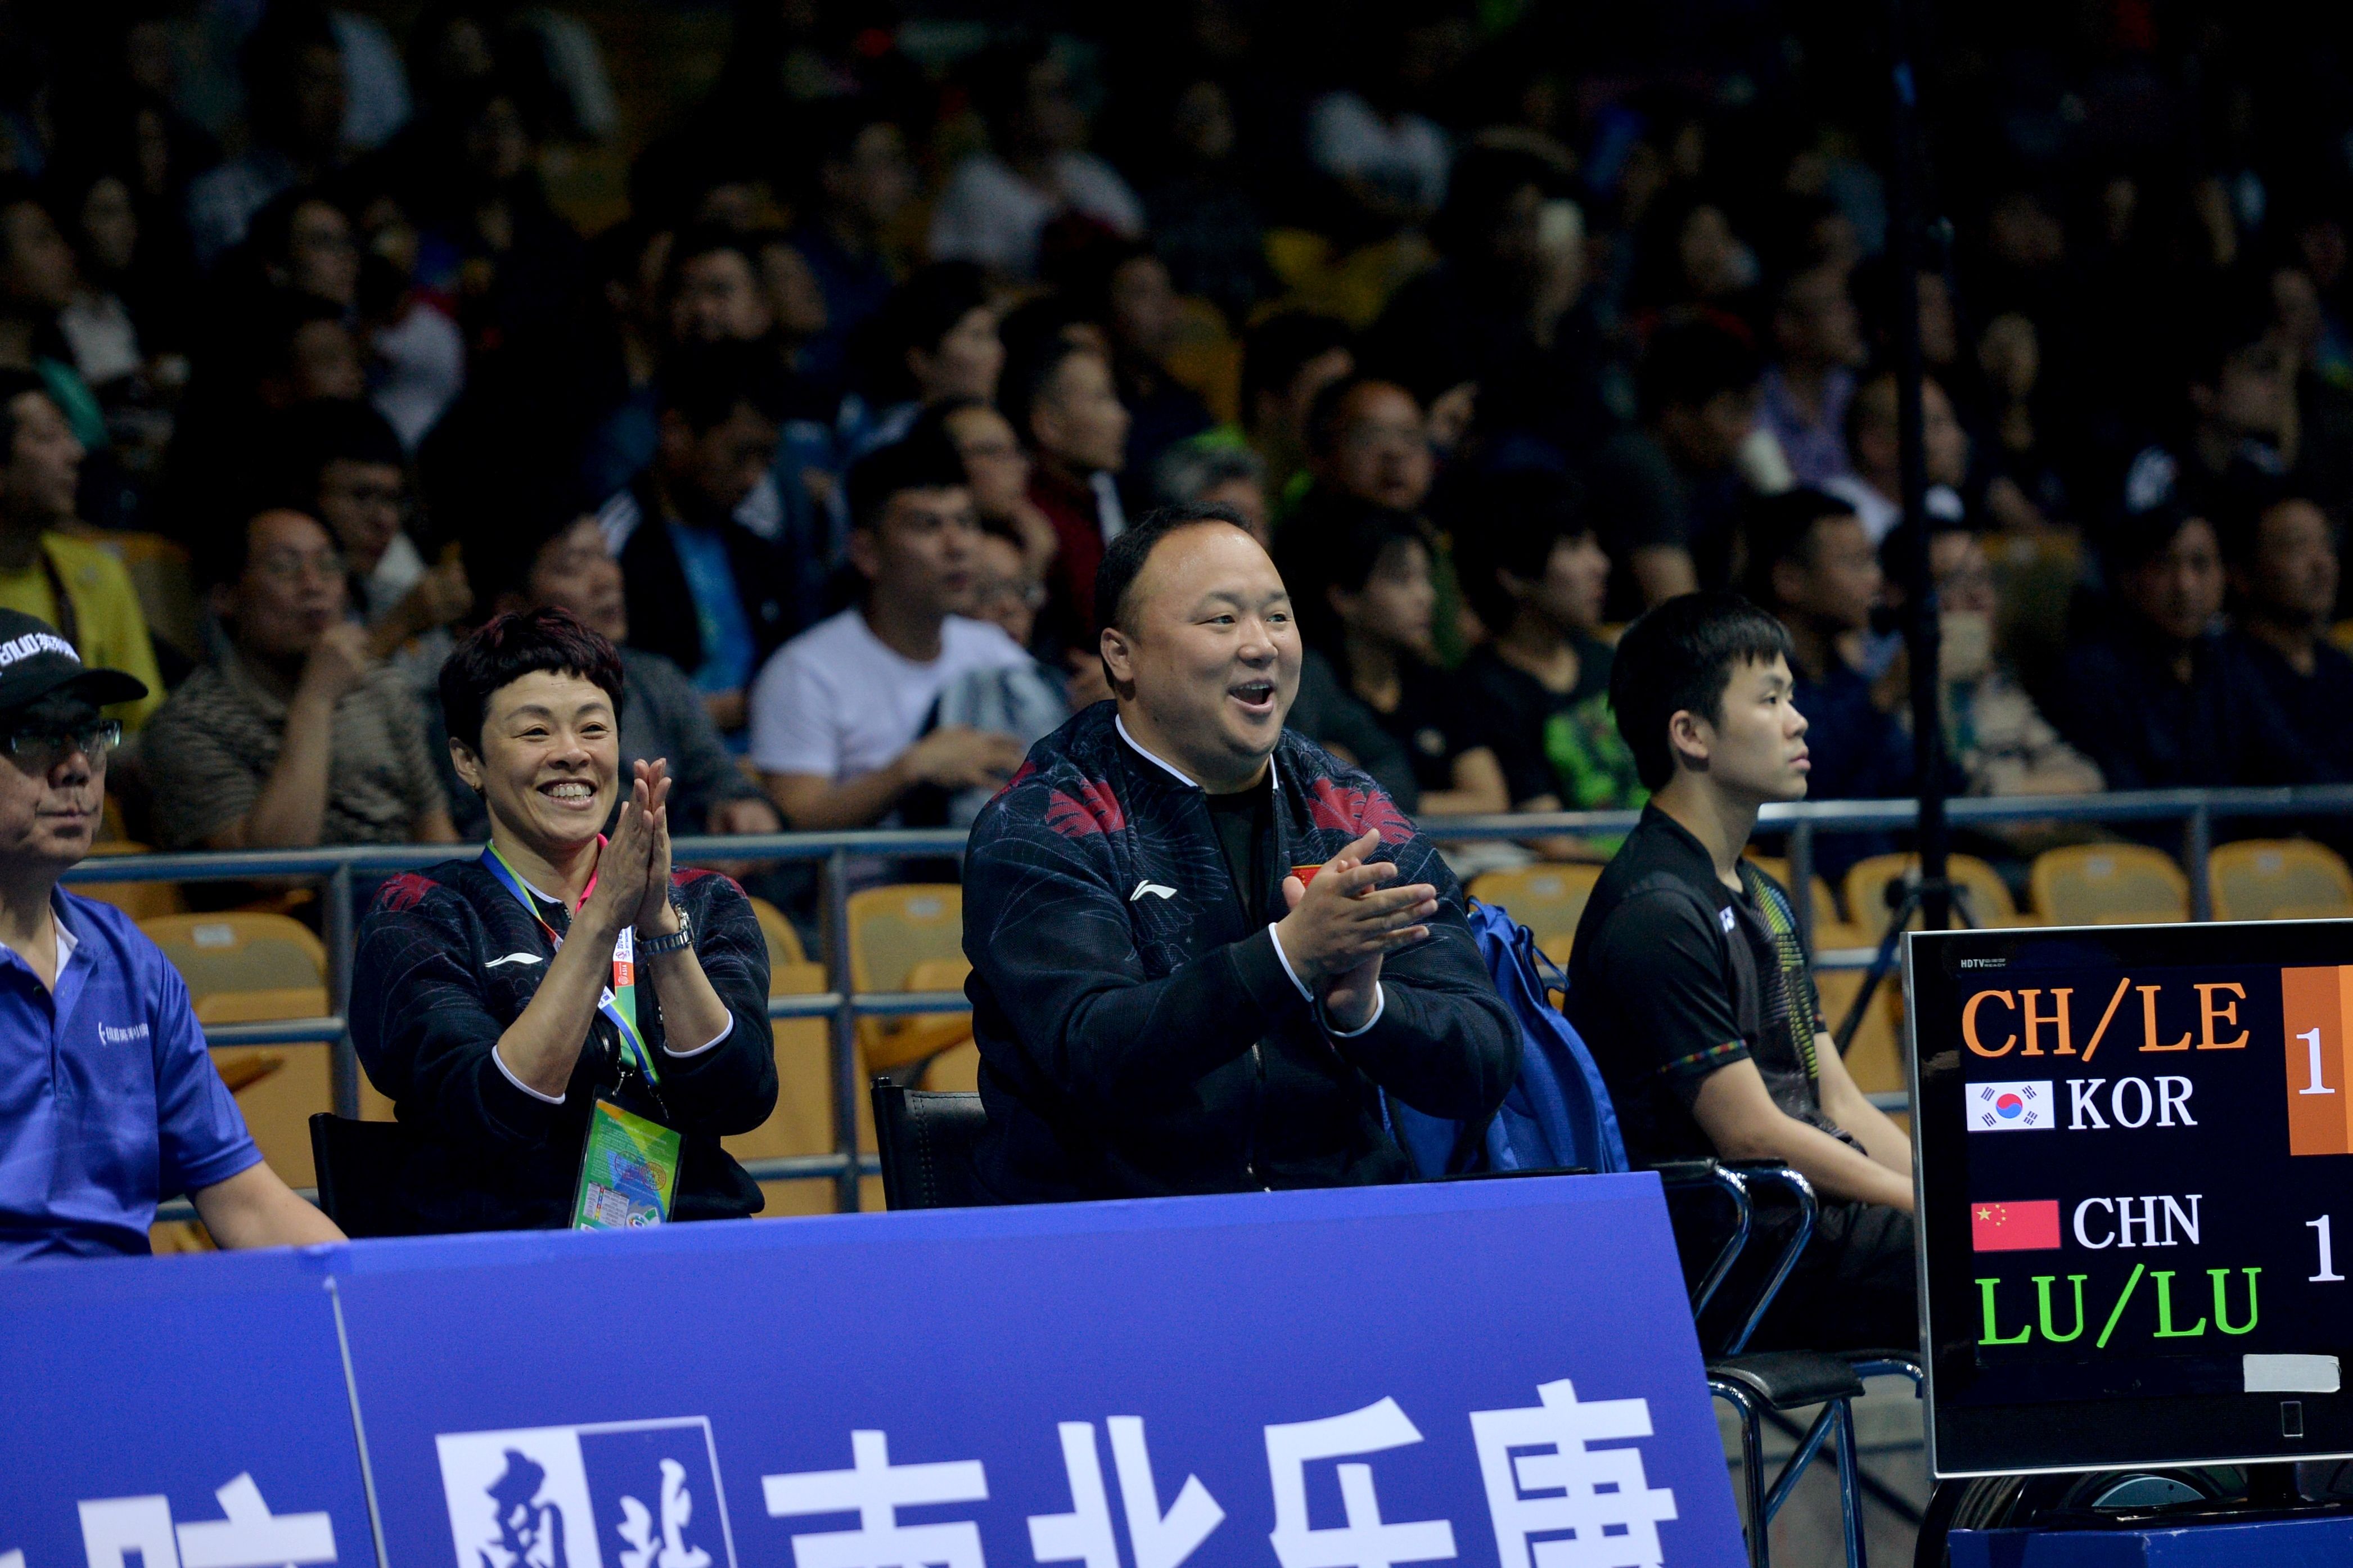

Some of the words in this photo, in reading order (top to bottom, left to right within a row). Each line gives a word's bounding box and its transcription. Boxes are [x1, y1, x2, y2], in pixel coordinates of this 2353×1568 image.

[1960, 959, 1985, 968] HDTV
[1962, 977, 2250, 1062] CH/LE
[2296, 1027, 2335, 1095] 1
[2066, 1076, 2198, 1130] KOR
[2073, 1194, 2203, 1249] CHN
[2305, 1214, 2345, 1282] 1
[1975, 1263, 2262, 1348] LU/LU
